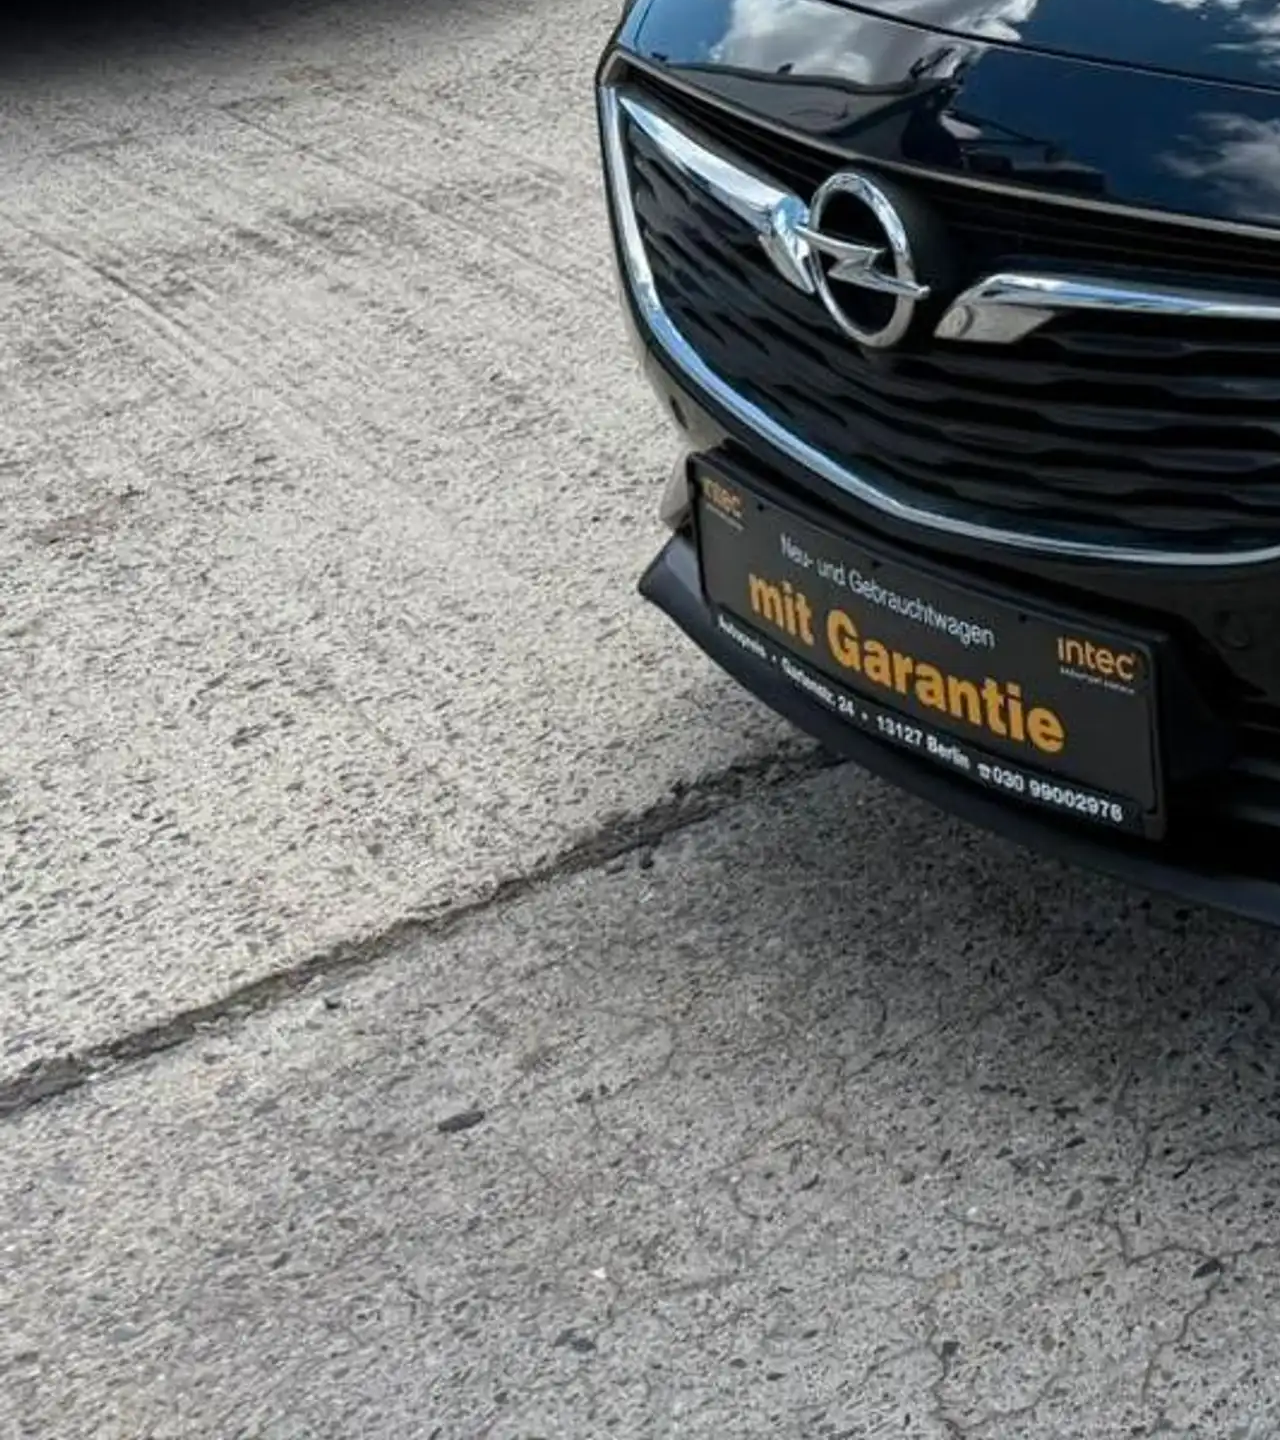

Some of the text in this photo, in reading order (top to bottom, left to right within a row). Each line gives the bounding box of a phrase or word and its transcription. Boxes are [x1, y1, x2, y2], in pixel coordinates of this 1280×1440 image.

[780, 532, 996, 649] Neu- und Gebrauchtwagen
[748, 573, 1066, 753] mit Garantie
[926, 735, 970, 770] Berlin
